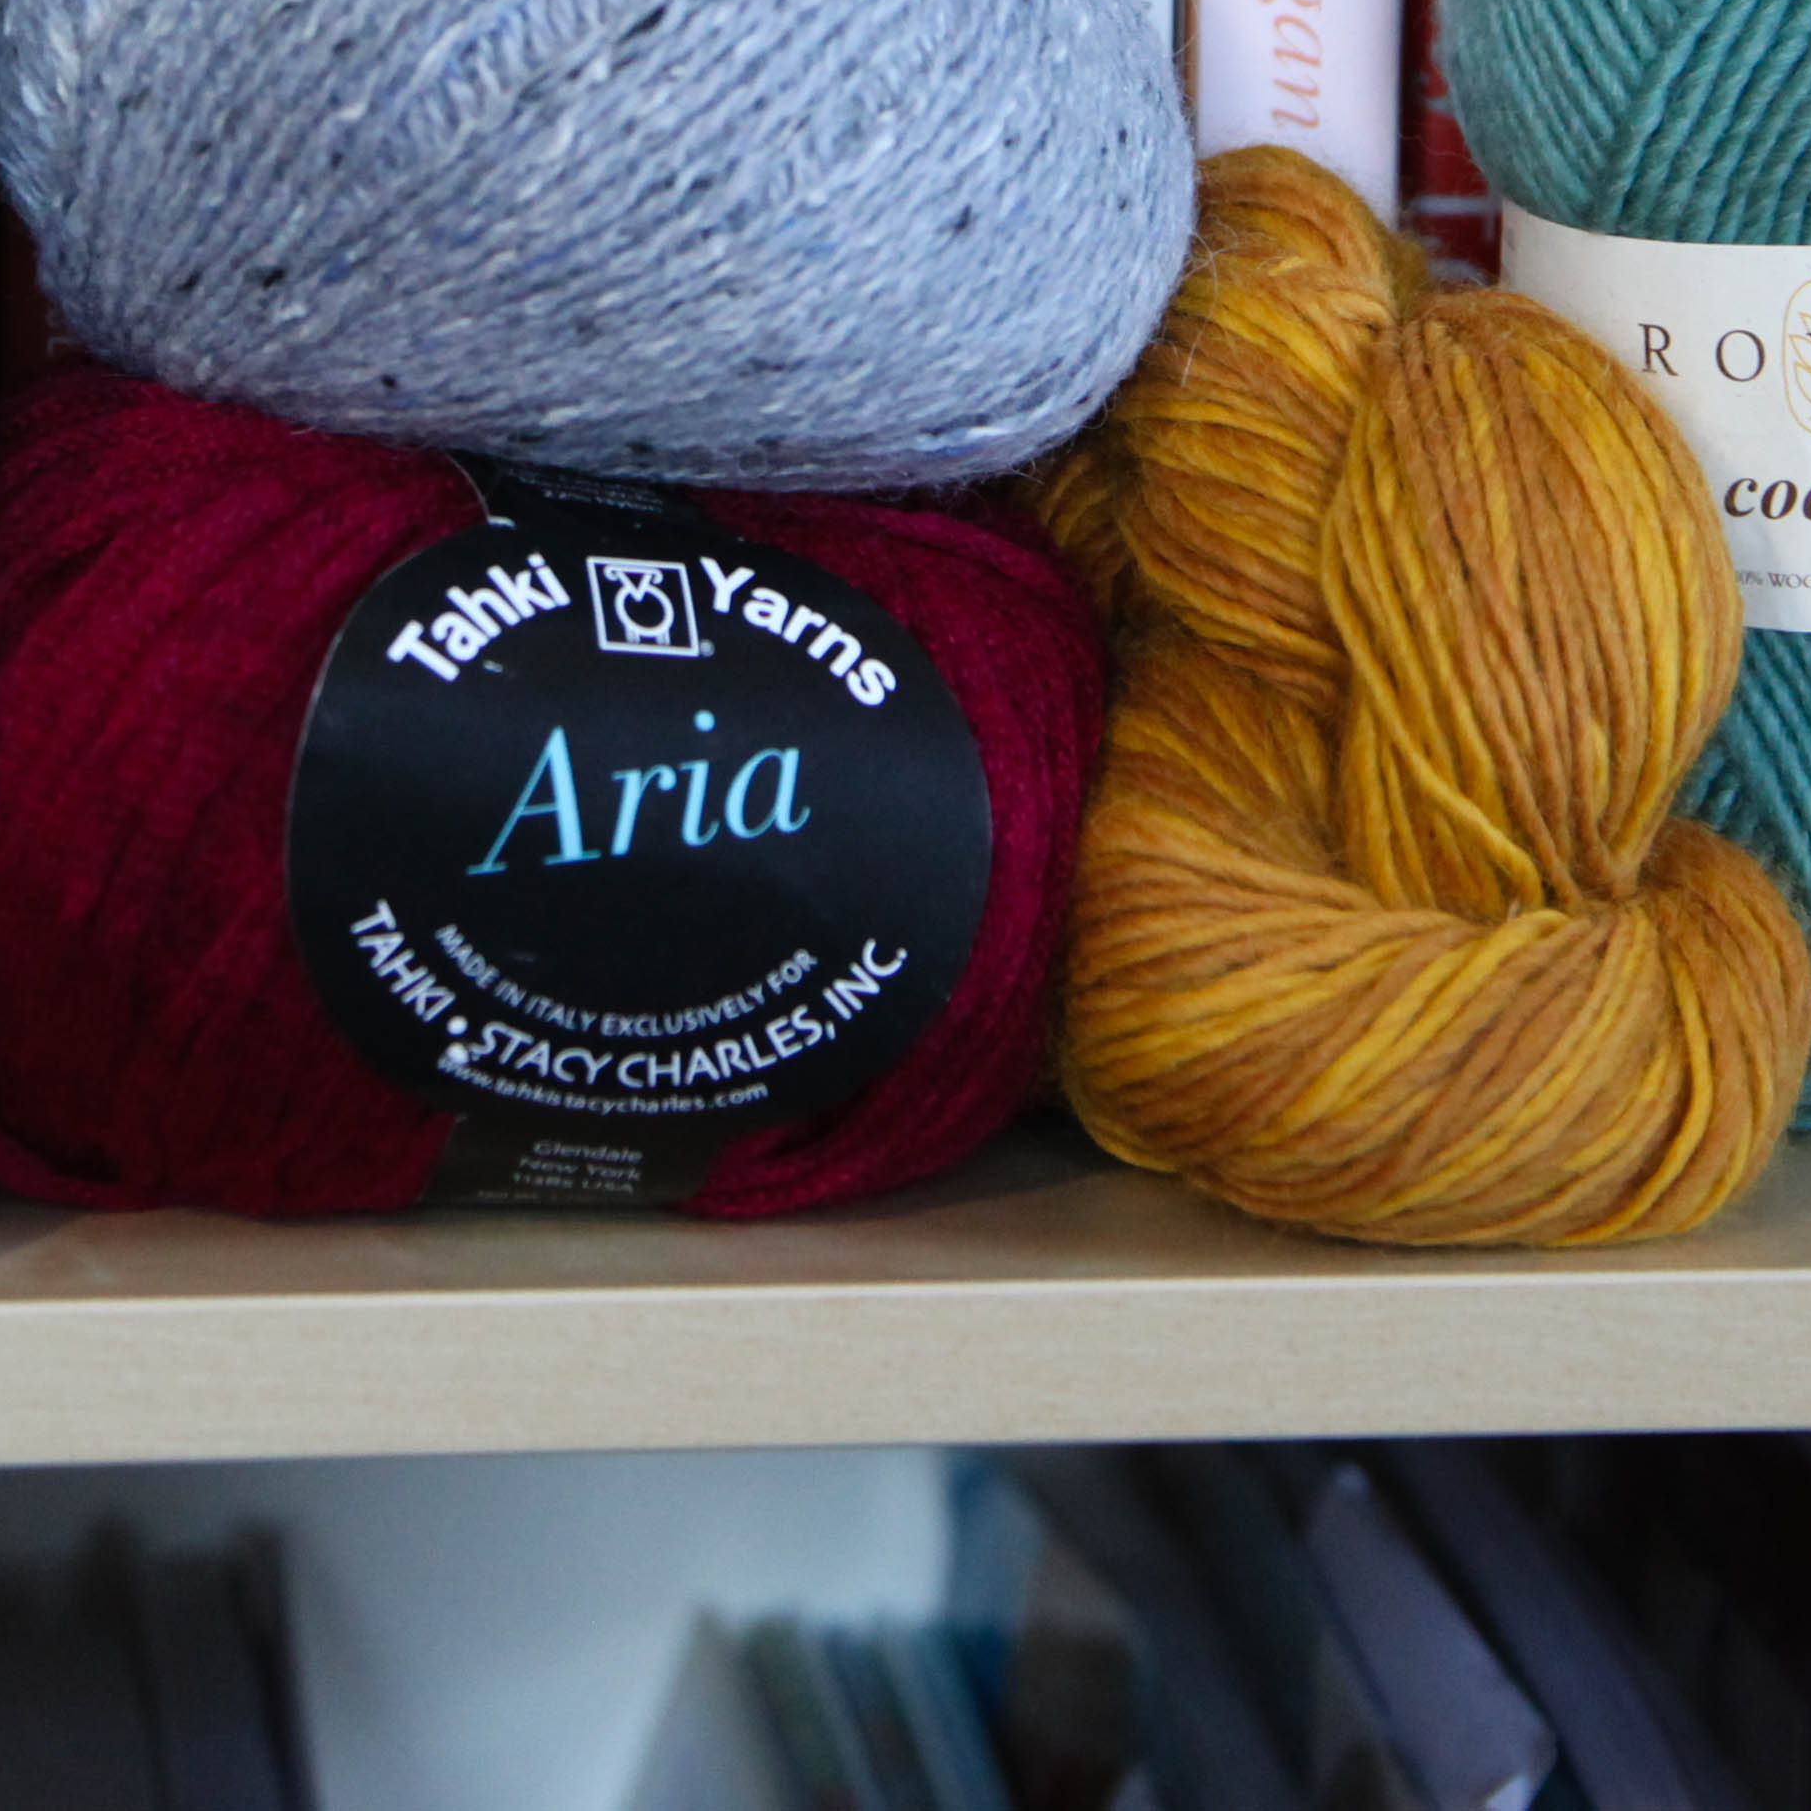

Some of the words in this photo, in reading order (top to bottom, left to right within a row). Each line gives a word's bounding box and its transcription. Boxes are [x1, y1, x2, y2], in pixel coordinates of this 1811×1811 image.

[388, 551, 572, 683] Tahki
[699, 556, 898, 707] Yarns
[466, 709, 812, 876] Aria
[349, 898, 457, 1023] TAHKI
[477, 1020, 614, 1086] STACY
[617, 1004, 837, 1089] CHARLES,
[822, 937, 909, 1021] INC.
[435, 924, 500, 989] MADE
[493, 976, 524, 1009] IN
[525, 989, 596, 1034] ITALY
[600, 983, 769, 1039] EXCLUSIVELY
[766, 947, 820, 998] FOR
[531, 1140, 644, 1166] Glendale
